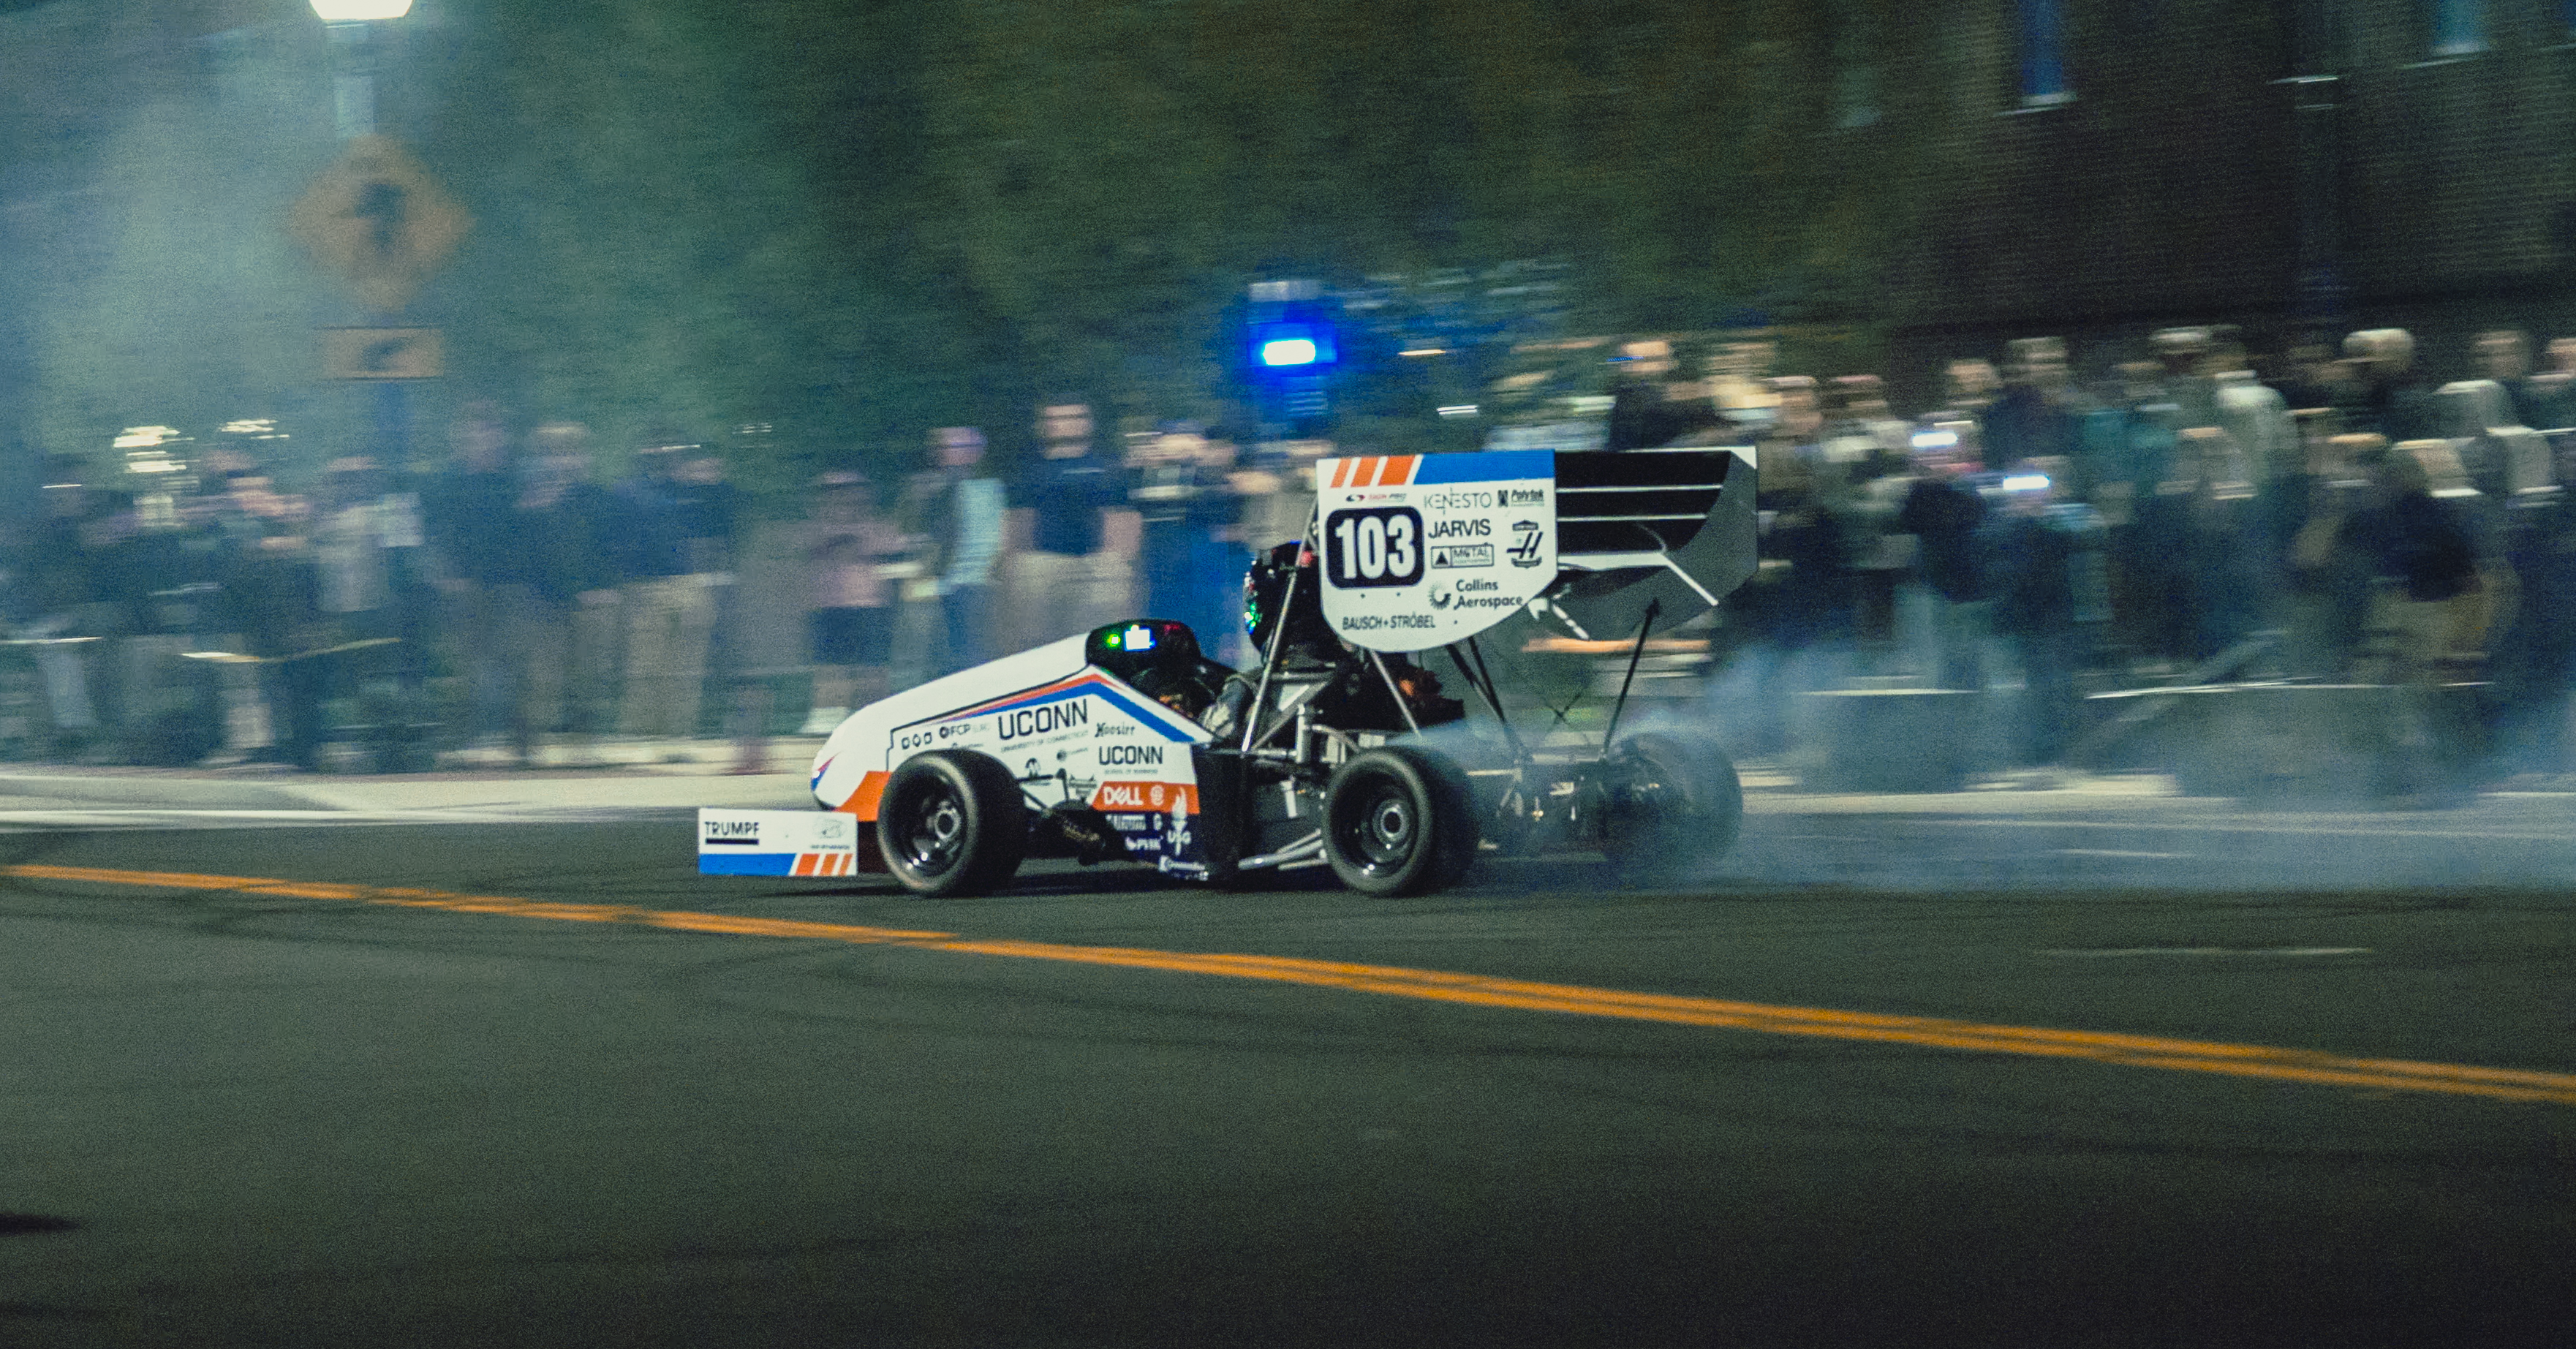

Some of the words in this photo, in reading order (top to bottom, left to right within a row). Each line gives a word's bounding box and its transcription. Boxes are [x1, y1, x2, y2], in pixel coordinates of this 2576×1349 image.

[1424, 488, 1492, 514] KENESTO
[1428, 518, 1492, 539] JARVIS
[1334, 514, 1416, 581] 103
[1456, 578, 1499, 592] Collins
[1457, 594, 1523, 610] Aerospace
[997, 698, 1088, 741] UCONN
[1098, 745, 1163, 766] UCONN
[1103, 786, 1144, 806] DELL
[704, 821, 759, 836] TRUMPF
